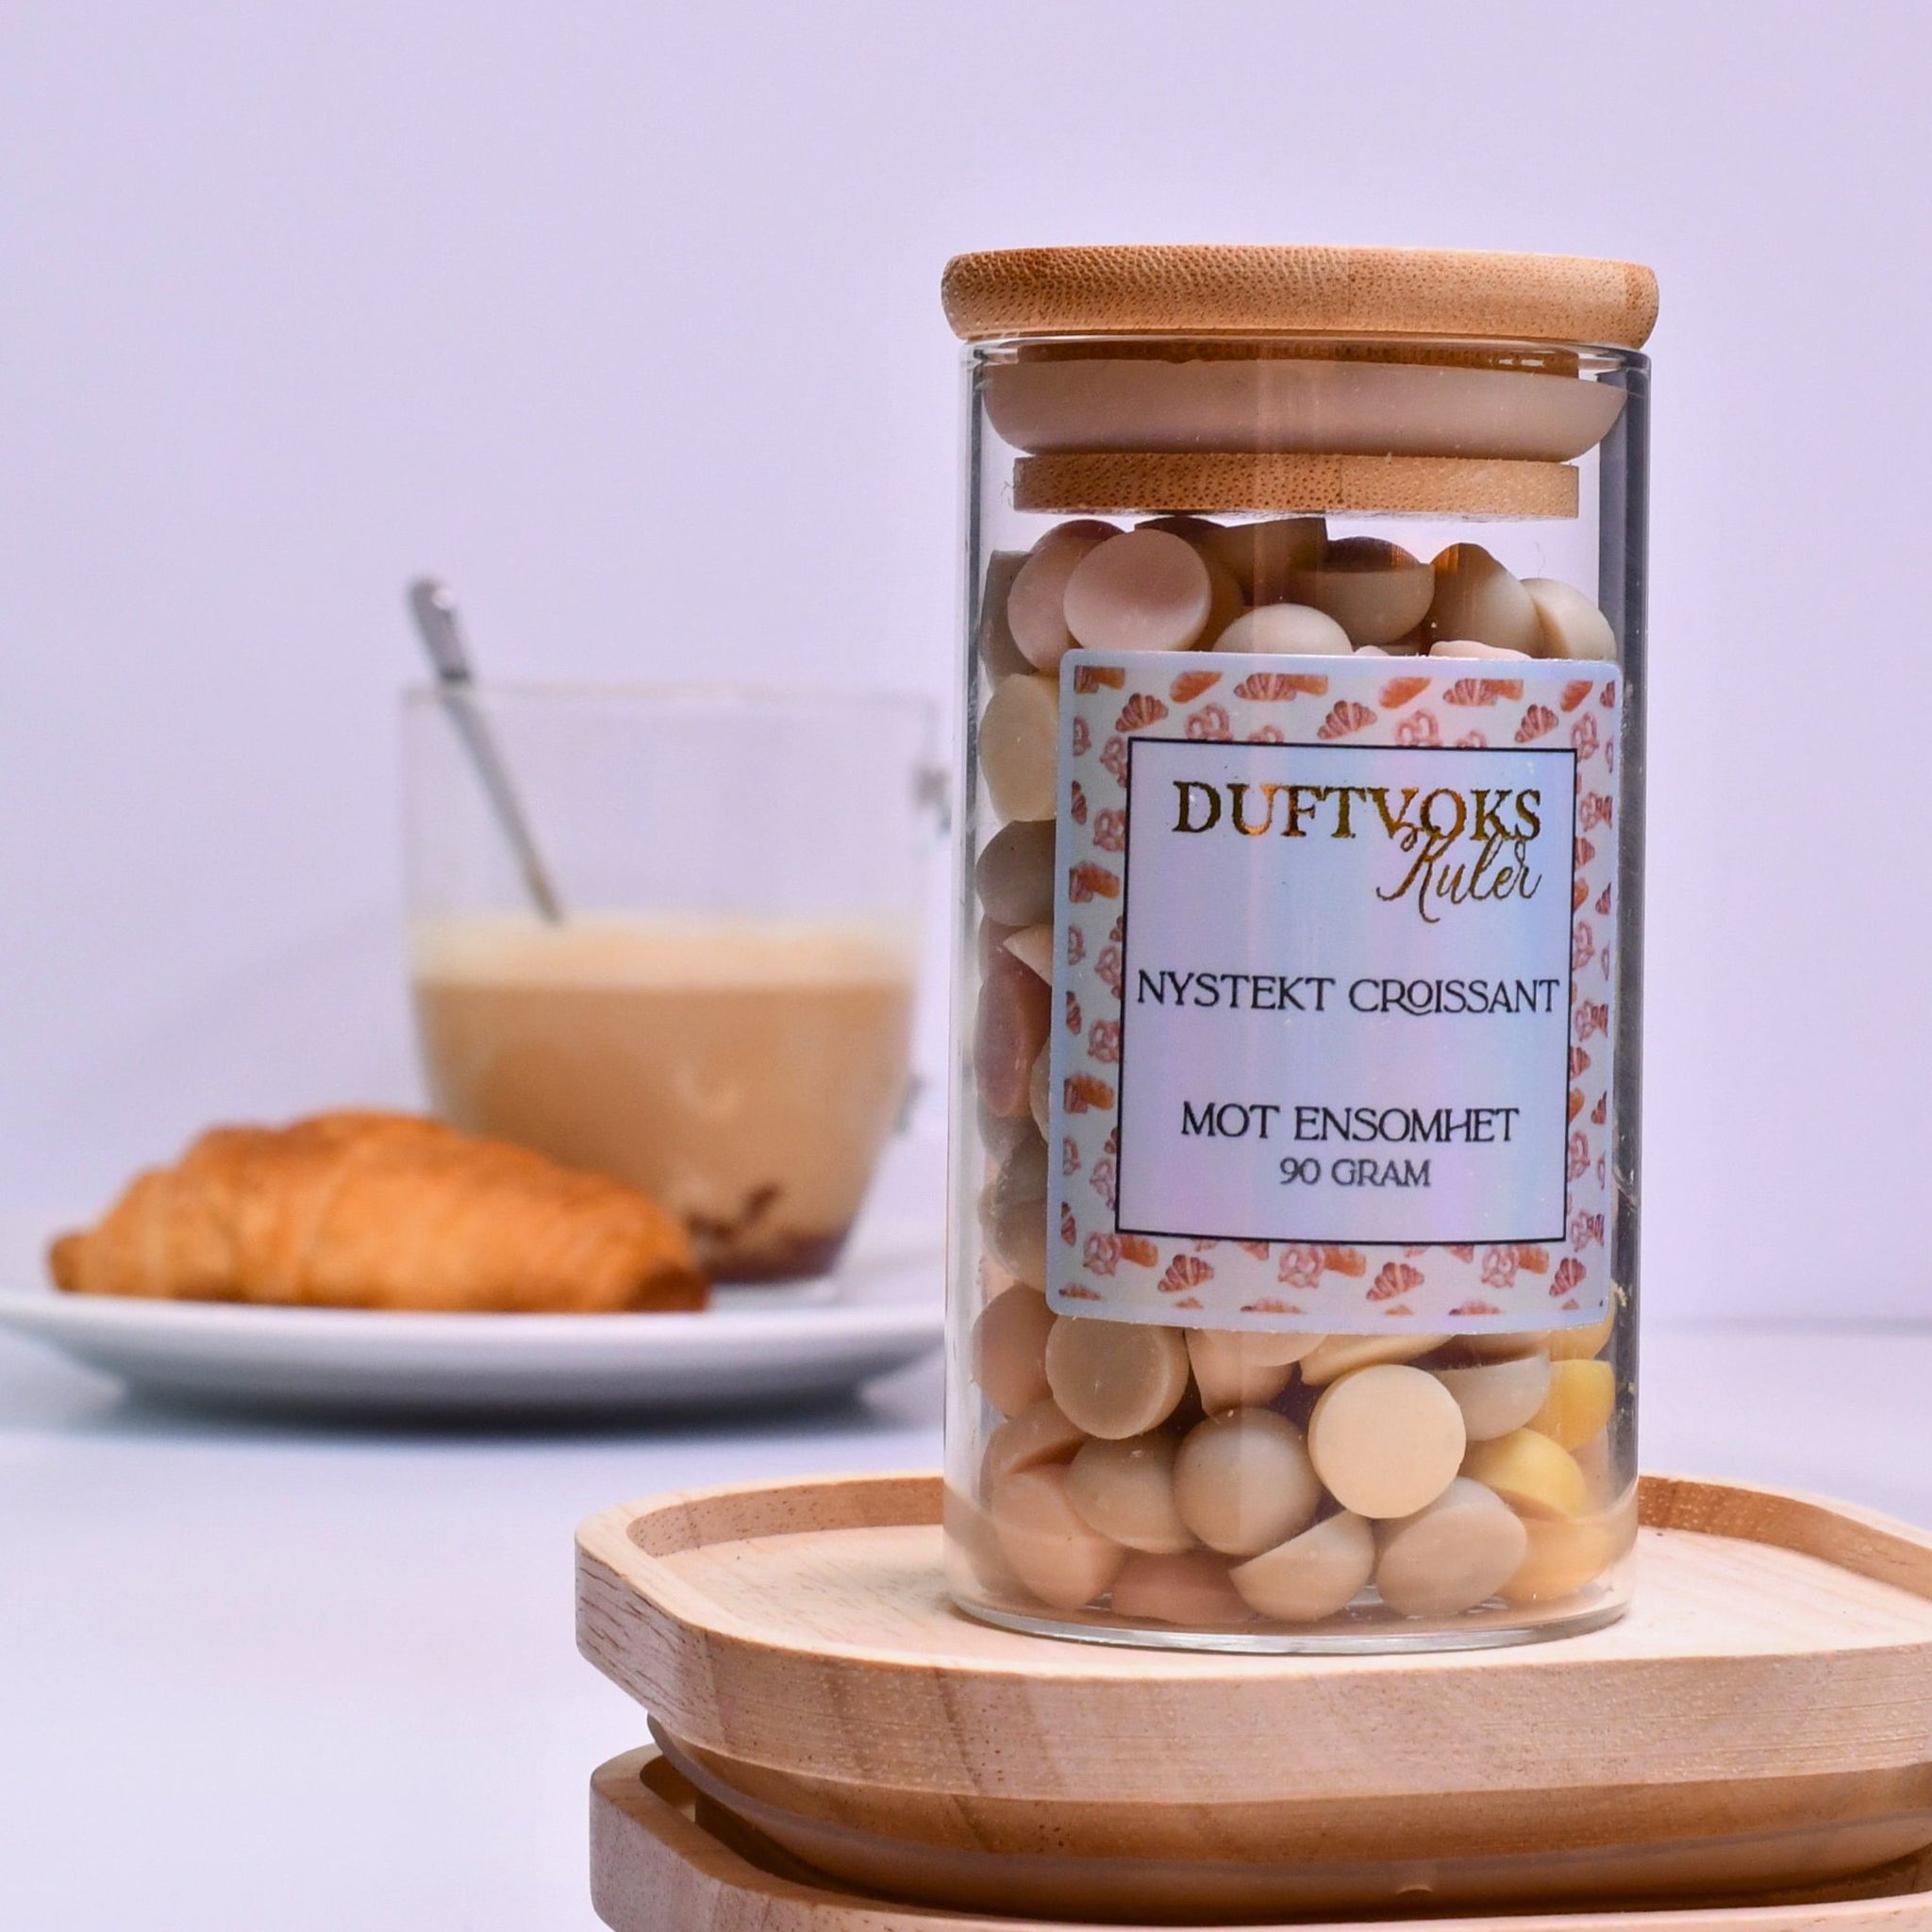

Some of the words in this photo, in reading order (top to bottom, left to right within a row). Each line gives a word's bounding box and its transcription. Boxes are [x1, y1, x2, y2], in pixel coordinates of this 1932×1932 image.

[1173, 780, 1541, 841] DUFTVOKS
[1137, 969, 1336, 1011] NYSTEKT
[1348, 978, 1560, 1016] CROISSANT
[1180, 1101, 1281, 1139] MOT
[1293, 1106, 1520, 1143] ENSOMHET
[1279, 1157, 1321, 1187] 90
[1331, 1158, 1431, 1188] GRAM
